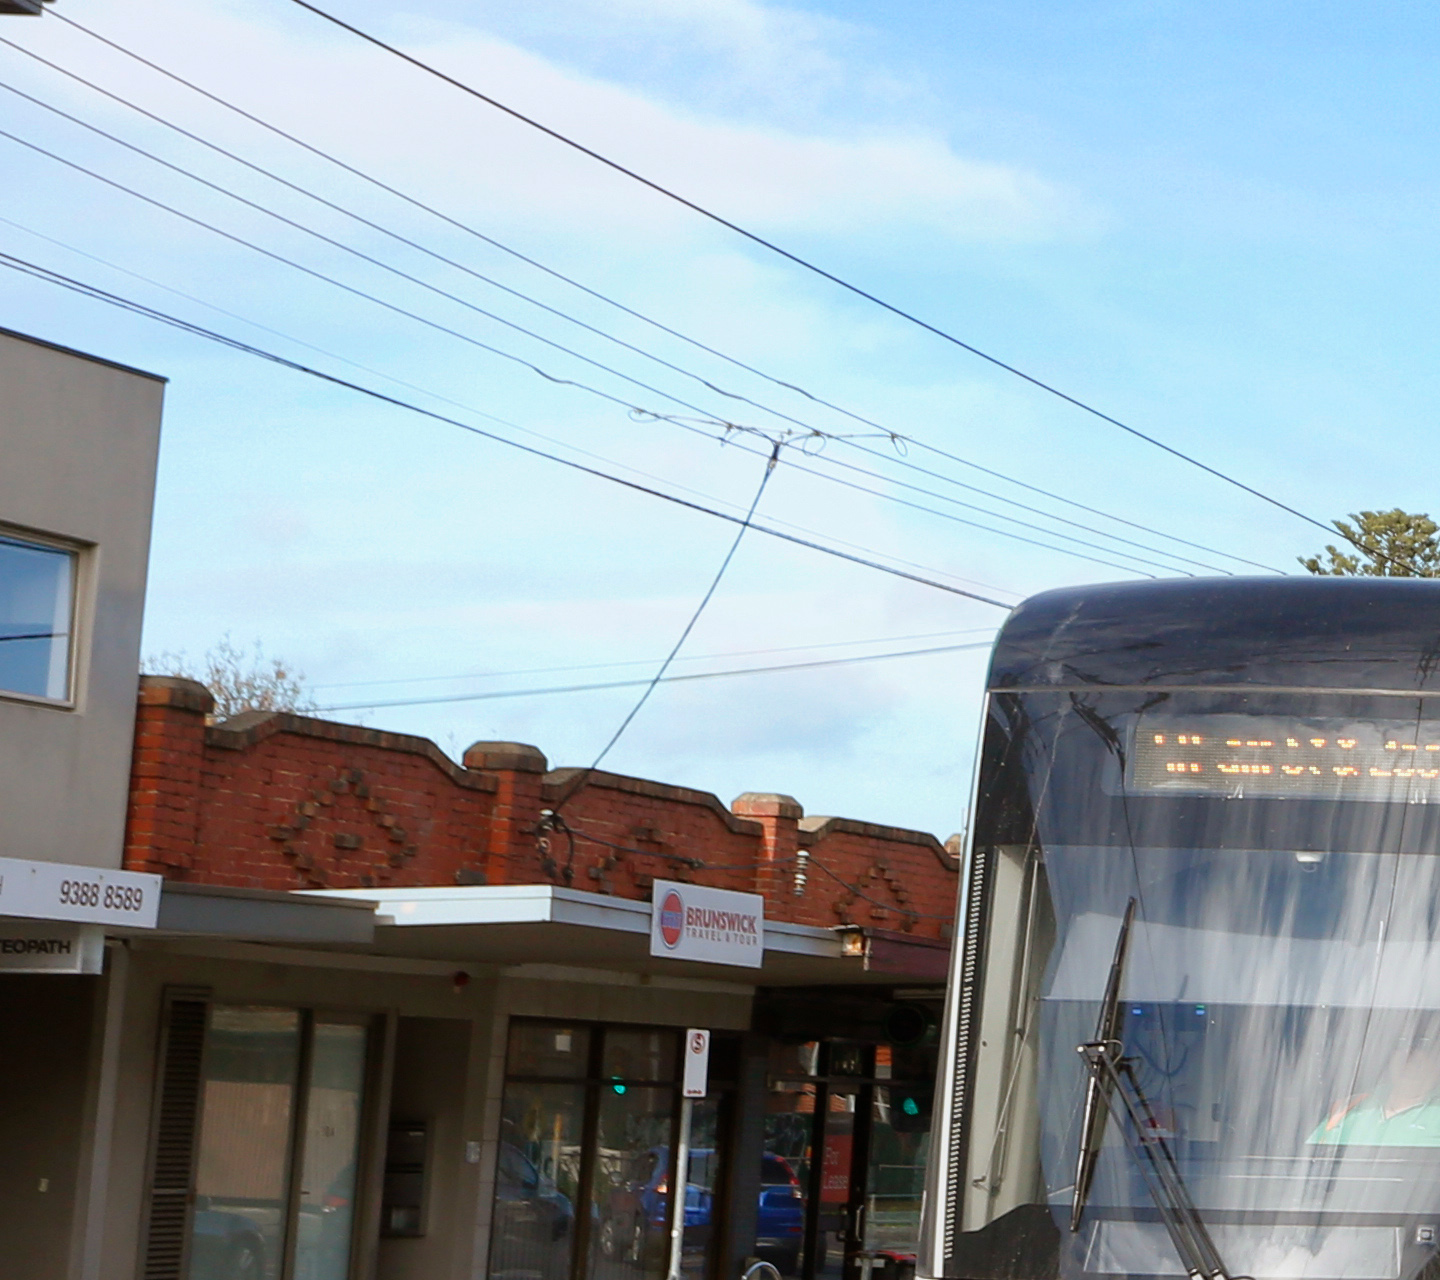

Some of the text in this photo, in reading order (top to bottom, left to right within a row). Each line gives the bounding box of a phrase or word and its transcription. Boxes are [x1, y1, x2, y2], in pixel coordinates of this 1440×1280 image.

[59, 879, 144, 912] 9388 8589
[686, 906, 758, 935] BRUNSWICK
[685, 927, 722, 942] TRAVEL
[733, 932, 758, 946] TOUR
